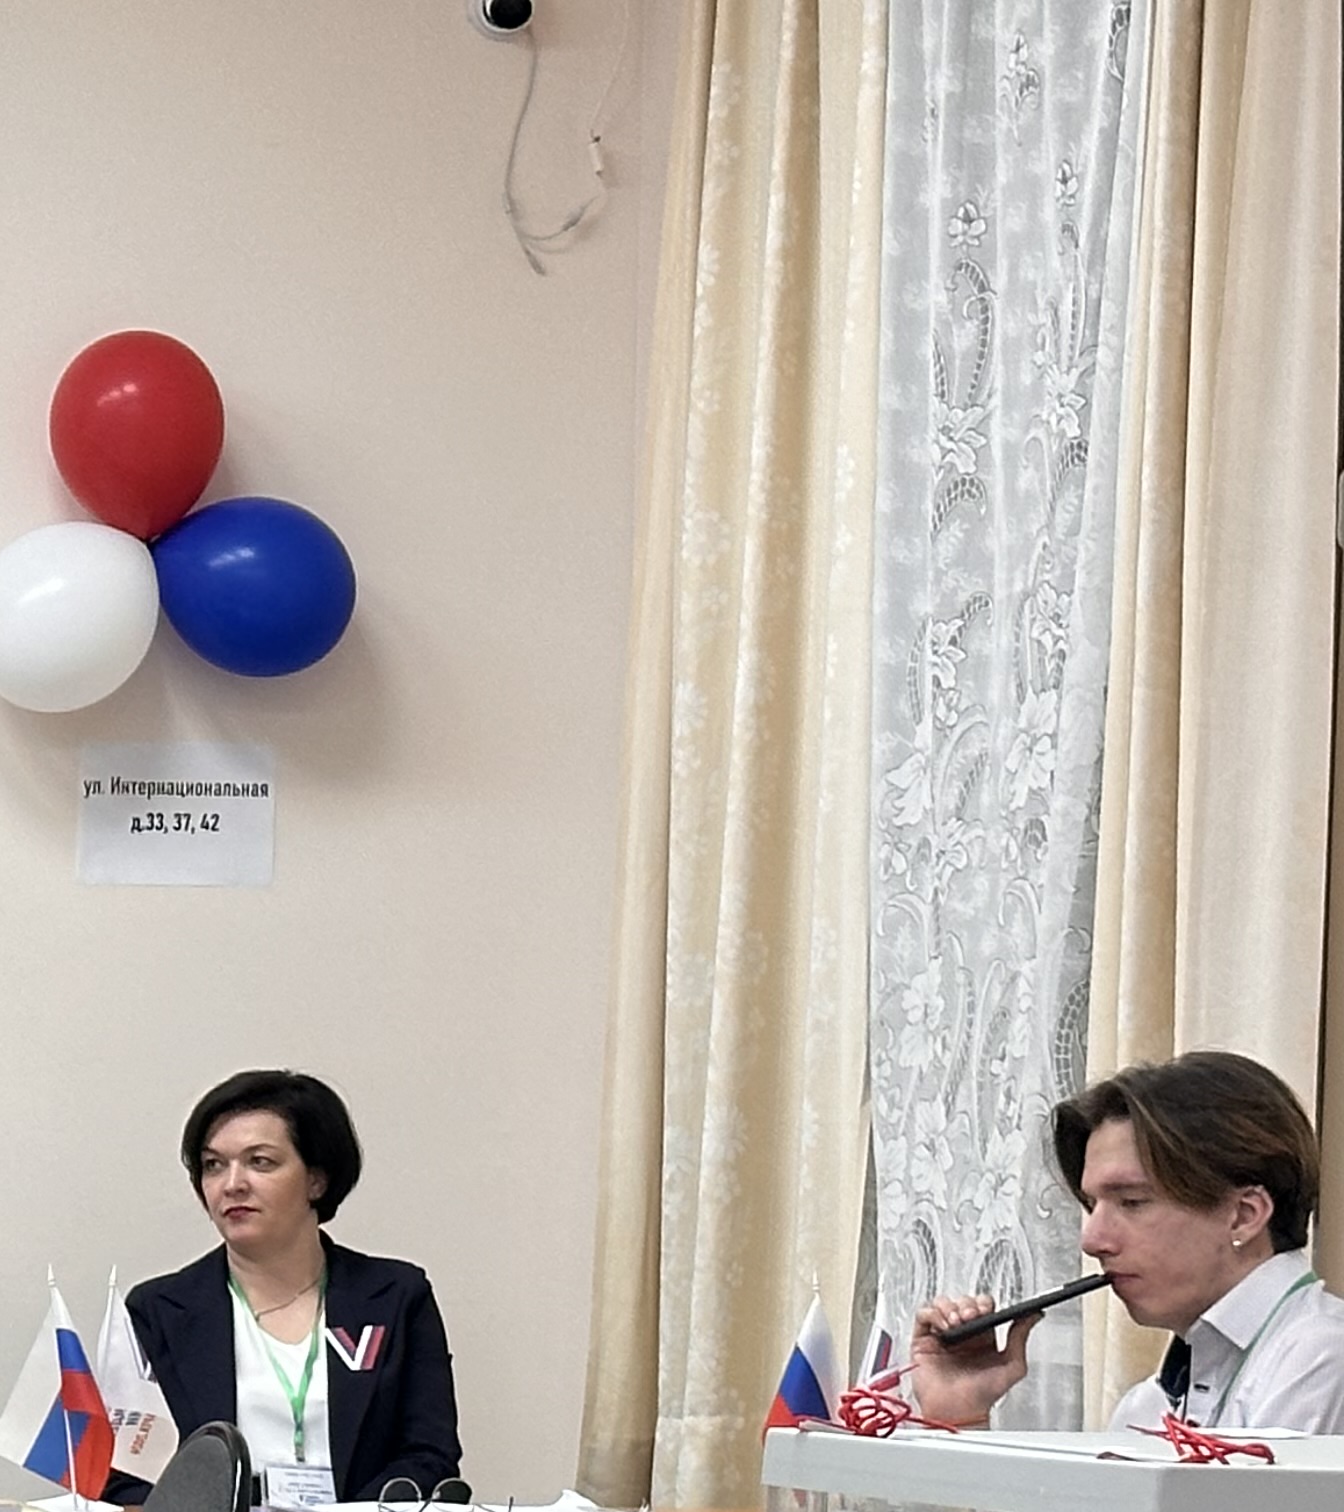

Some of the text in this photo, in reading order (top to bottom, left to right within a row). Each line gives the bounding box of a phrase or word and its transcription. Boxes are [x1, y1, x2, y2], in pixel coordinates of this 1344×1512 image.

[83, 776, 270, 800] ул. Интернациональная
[130, 812, 221, 834] д.33, 37, 42
